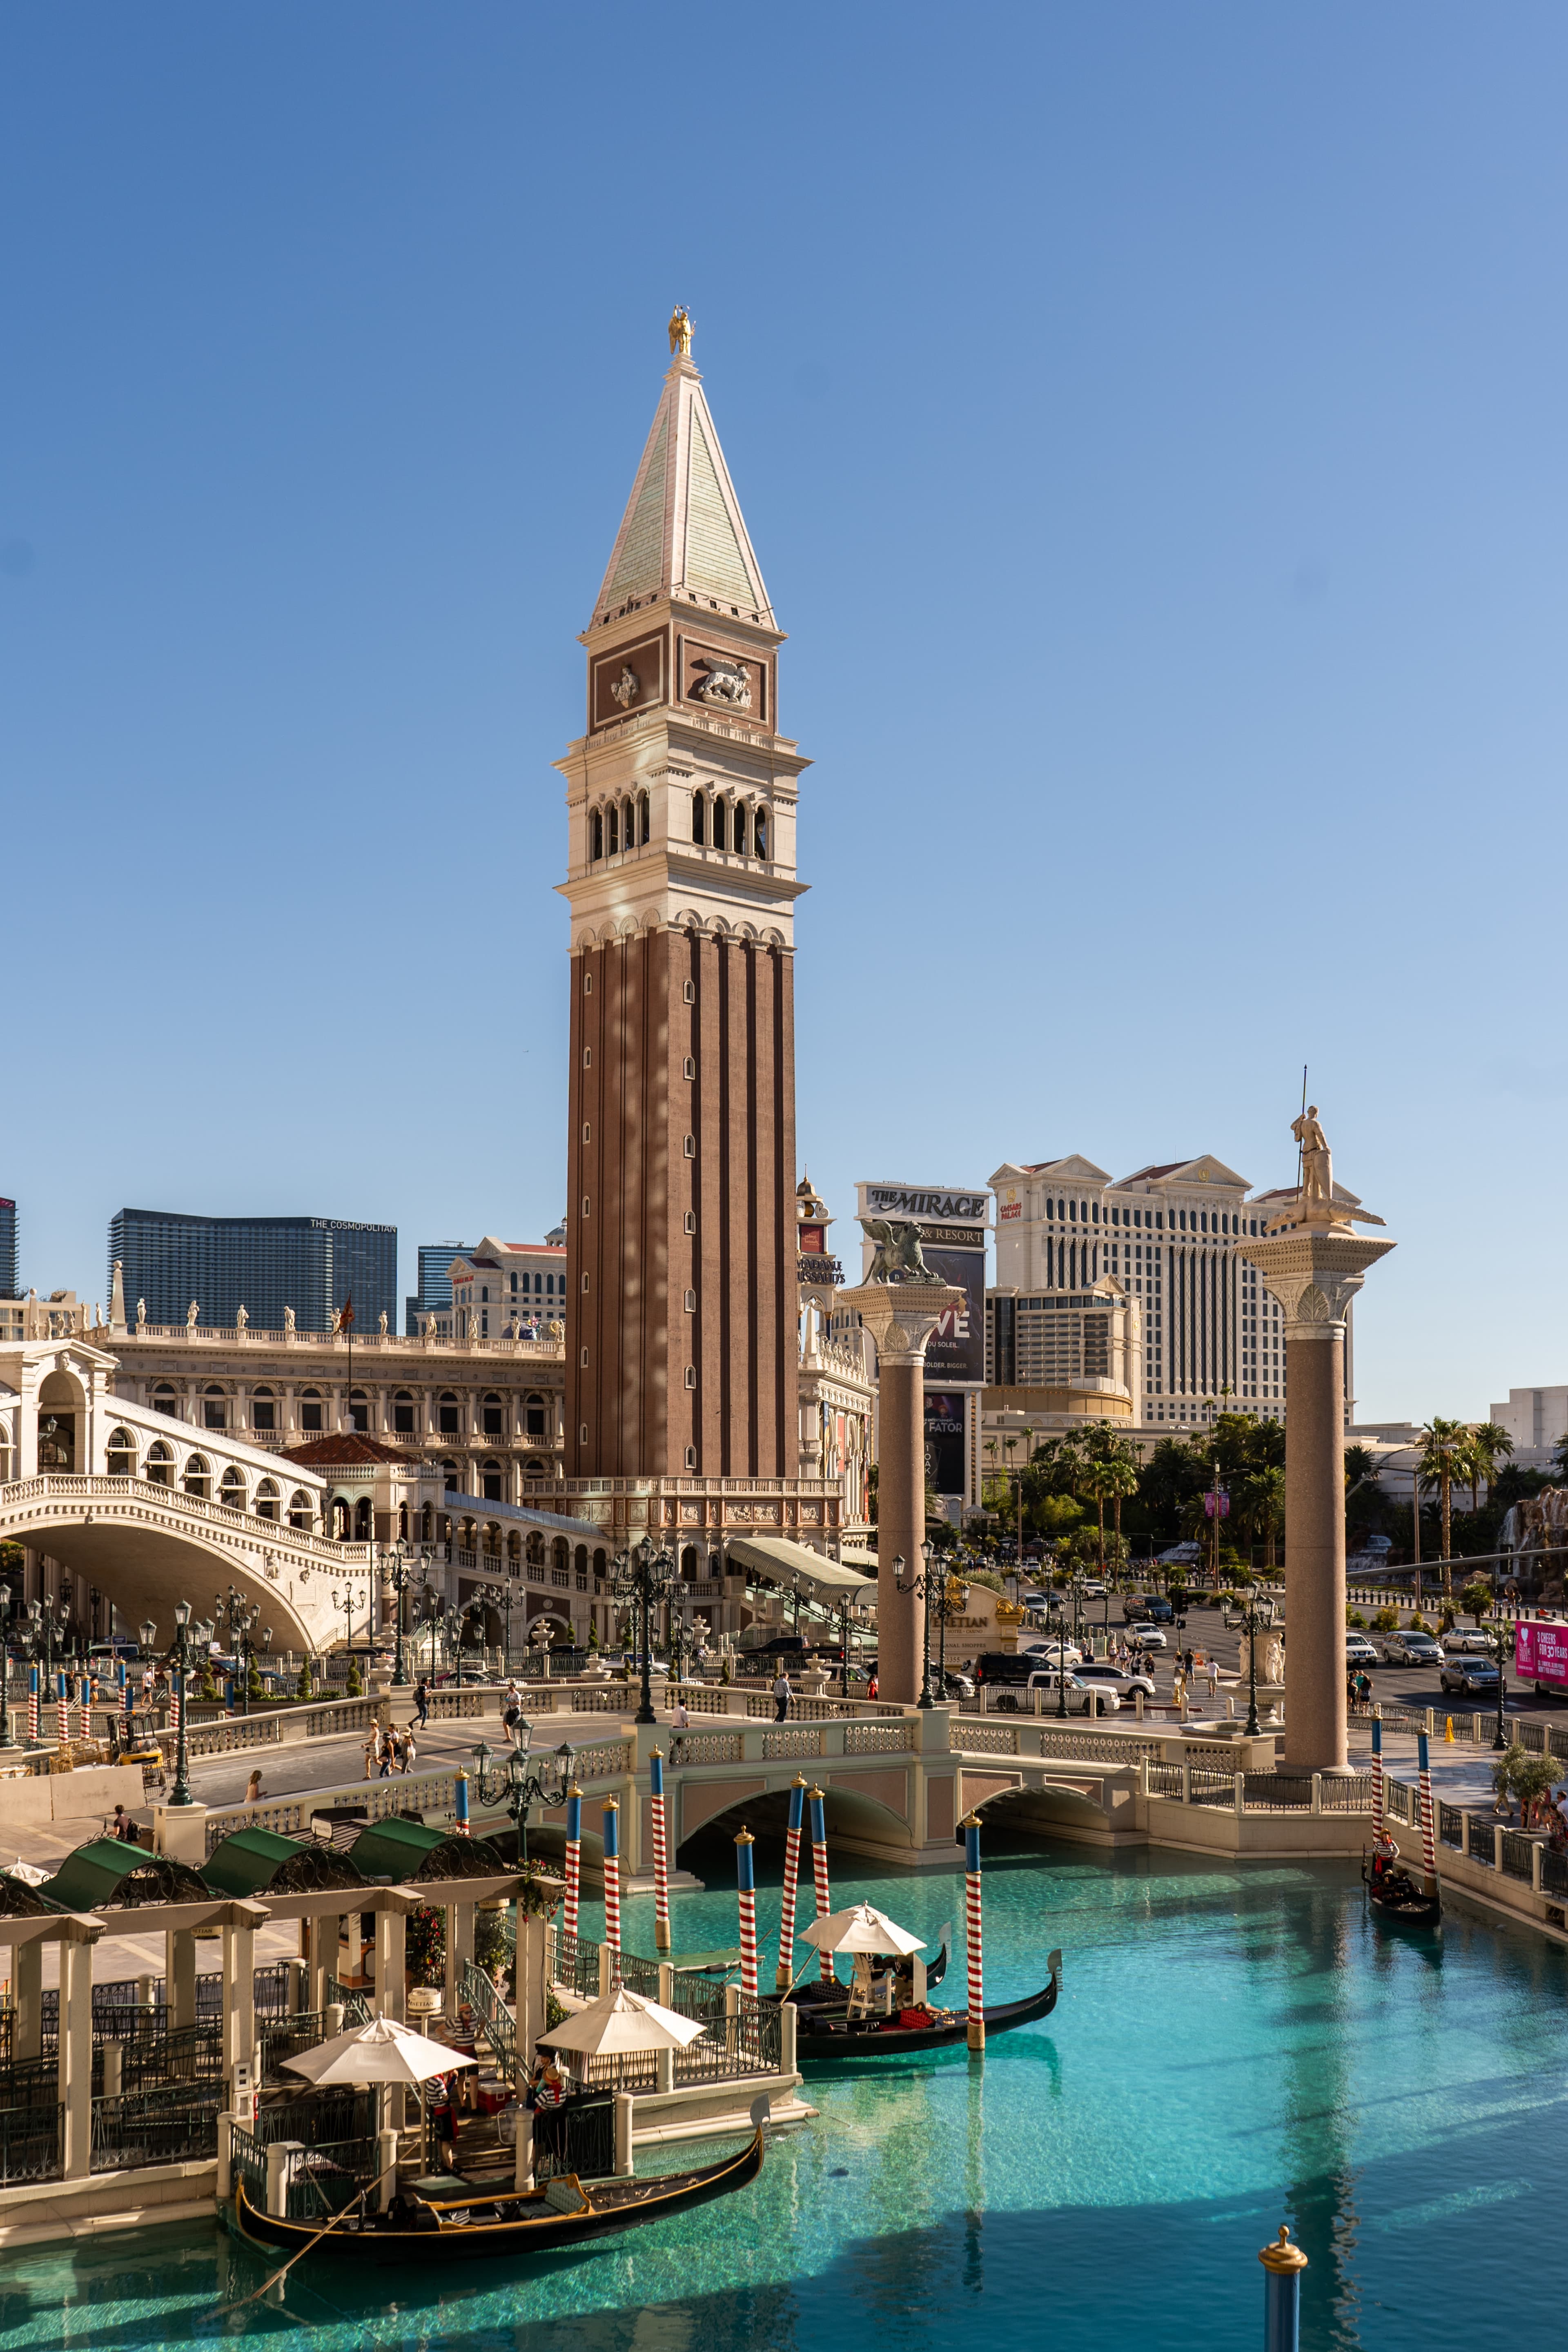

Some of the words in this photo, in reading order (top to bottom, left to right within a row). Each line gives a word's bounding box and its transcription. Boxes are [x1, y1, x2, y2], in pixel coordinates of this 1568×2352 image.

[872, 1190, 897, 1202] THE
[879, 1192, 984, 1218] MIRAGE
[1000, 1202, 1022, 1213] CAESARS
[1001, 1210, 1020, 1220] PALACE
[311, 1219, 327, 1228] THE
[330, 1221, 396, 1232] COSMOPOLITAN
[925, 1229, 932, 1238] &
[936, 1228, 982, 1242] RESORT
[797, 1271, 845, 1284] USSAUD'S
[937, 1310, 970, 1338] VE
[929, 1422, 962, 1432] FATOR
[1537, 1631, 1540, 1642] 3
[1541, 1632, 1556, 1644] CHEERS
[1547, 1646, 1554, 1658] 30
[1555, 1646, 1567, 1659] YEARS
